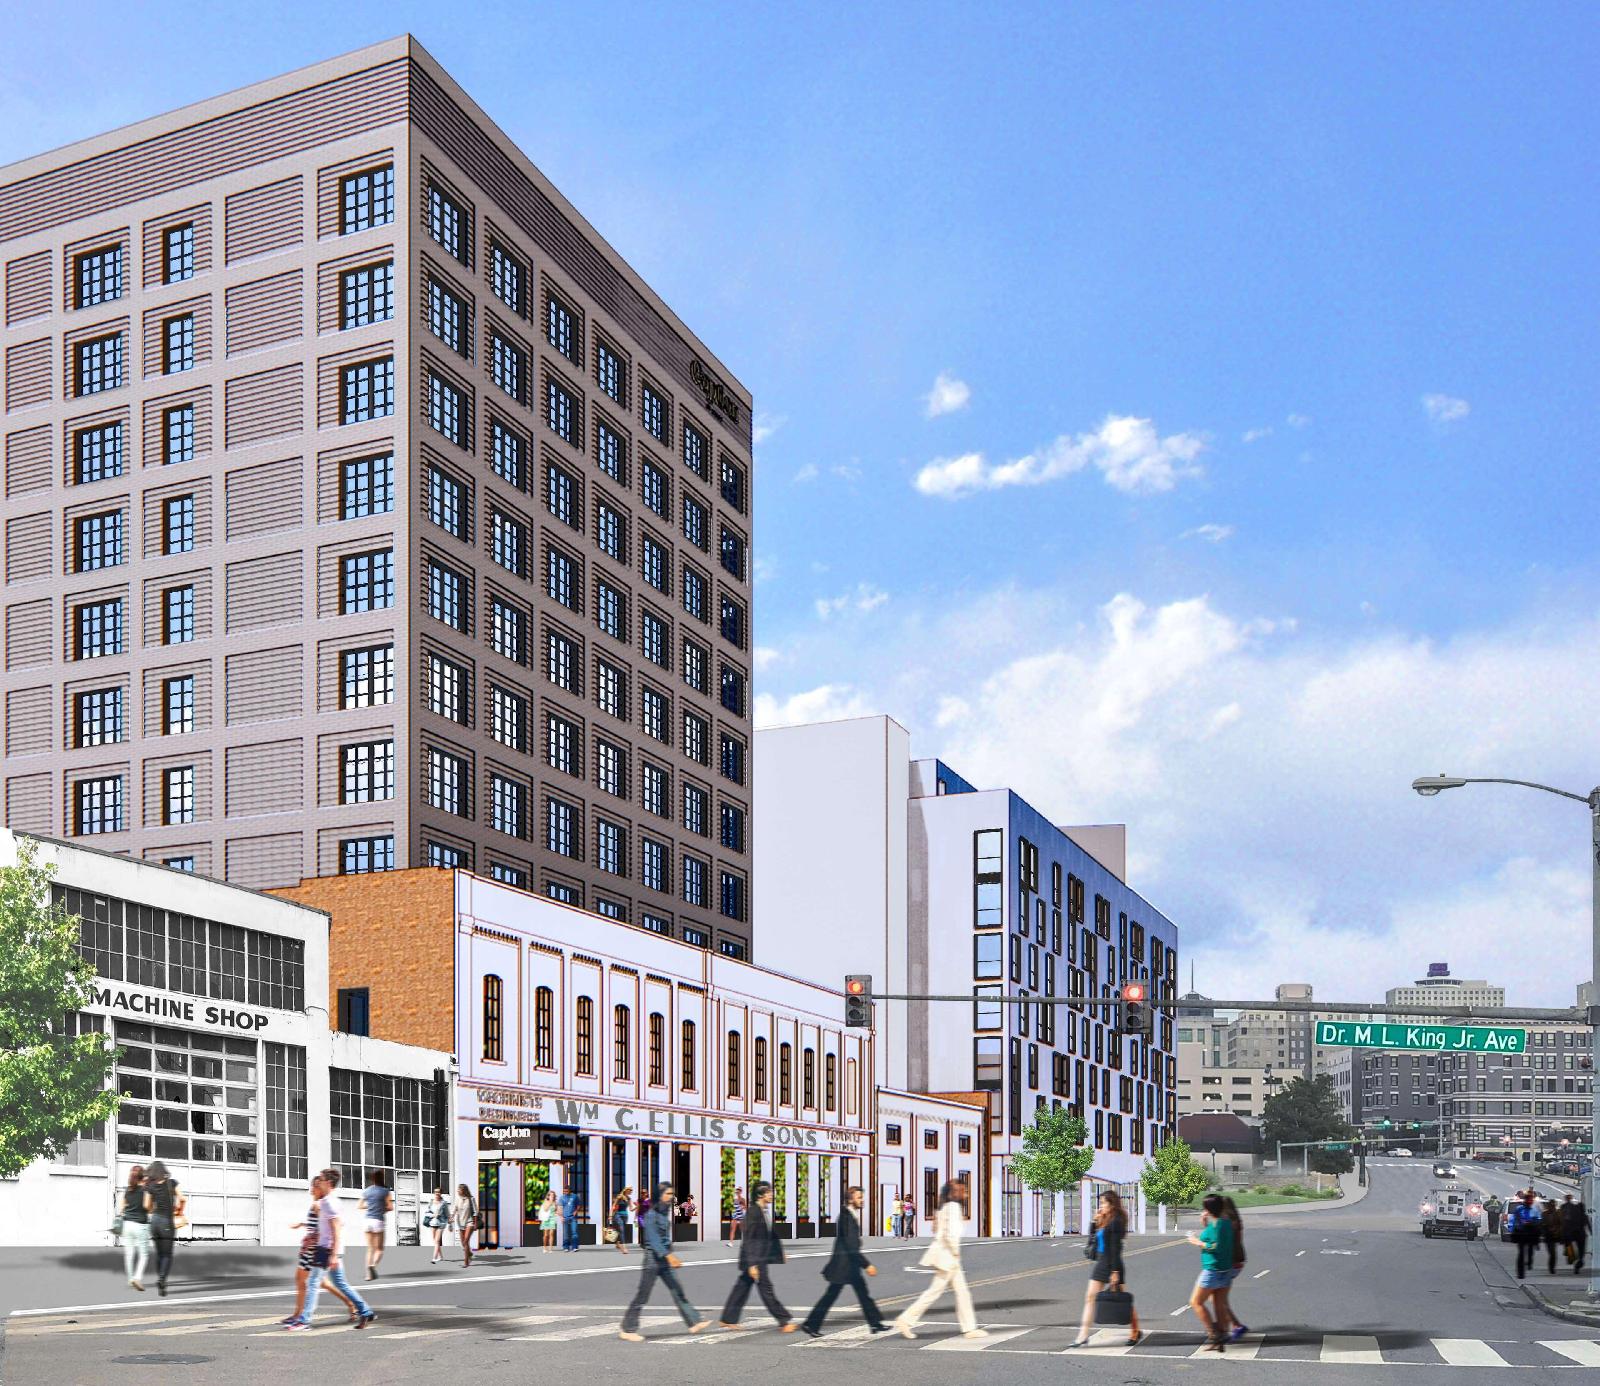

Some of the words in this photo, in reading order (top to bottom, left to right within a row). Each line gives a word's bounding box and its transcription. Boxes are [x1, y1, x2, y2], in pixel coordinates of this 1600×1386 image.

[91, 986, 194, 1021] MACHINE
[205, 1006, 269, 1031] SHOP
[1322, 1024, 1348, 1044] Dr.
[1354, 1026, 1375, 1045] M.
[1381, 1027, 1400, 1046] L.
[1406, 1028, 1446, 1050] King
[1452, 1029, 1478, 1049] Jr.
[1484, 1031, 1518, 1050] Ave
[482, 1125, 531, 1142] Caption
[649, 1110, 725, 1139] ELLIS
[737, 1121, 752, 1141] &
[762, 1124, 817, 1148] SONS
